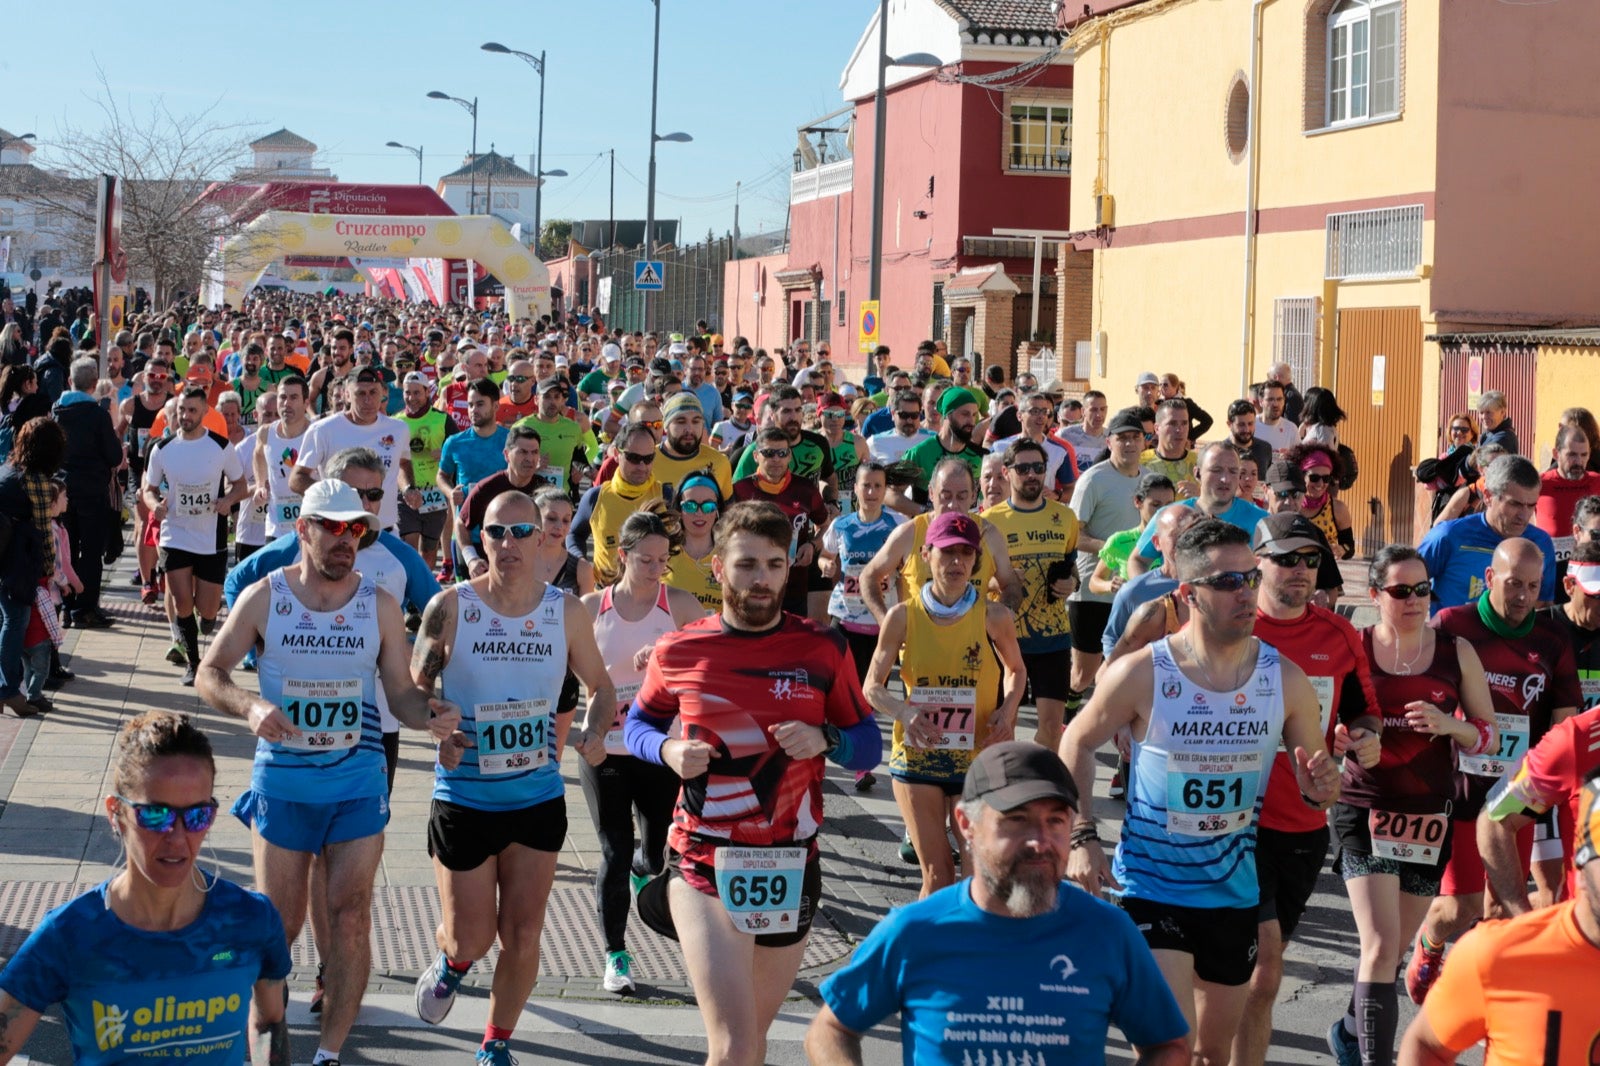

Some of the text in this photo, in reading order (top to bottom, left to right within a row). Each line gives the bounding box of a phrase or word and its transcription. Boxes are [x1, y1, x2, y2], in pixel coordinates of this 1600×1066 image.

[334, 191, 387, 203] Diputación
[334, 204, 387, 214] de Granada
[335, 221, 426, 238] Cruzcampo
[344, 240, 387, 253] Radler
[180, 493, 211, 506] 3143
[422, 491, 442, 506] 42
[1026, 530, 1065, 543] Vigilsa
[281, 633, 365, 649] MARACENA
[472, 641, 552, 656] MARACENA
[302, 681, 316, 689] GRAN
[317, 681, 335, 689] PREMIO
[336, 681, 342, 689] DE
[343, 680, 358, 689] FONDO
[495, 703, 509, 711] GRAN
[509, 701, 527, 710] PREMIO
[288, 701, 358, 728] 1079
[1171, 720, 1269, 737] MARACENA
[1383, 717, 1411, 728] NNE
[483, 719, 544, 750] 1081
[1192, 753, 1208, 762] GRAN
[1209, 754, 1230, 763] PREMIO
[1231, 754, 1238, 762] DE
[1239, 753, 1258, 761] FONDO
[1183, 777, 1242, 809] 651
[1373, 811, 1443, 843] 2010
[752, 850, 773, 859] PREMIO
[775, 850, 782, 859] DE
[783, 850, 801, 859] FONDO
[729, 875, 787, 907] 659
[133, 993, 241, 1027] olimpo
[987, 996, 1024, 1011] XIII
[946, 1011, 1066, 1027] Carrera Popular
[130, 1025, 202, 1044] deportes
[944, 1028, 978, 1041] Puerto
[1009, 1030, 1023, 1043] de
[1023, 1031, 1070, 1047] Algeciras
[1360, 998, 1384, 1064] kalenji
